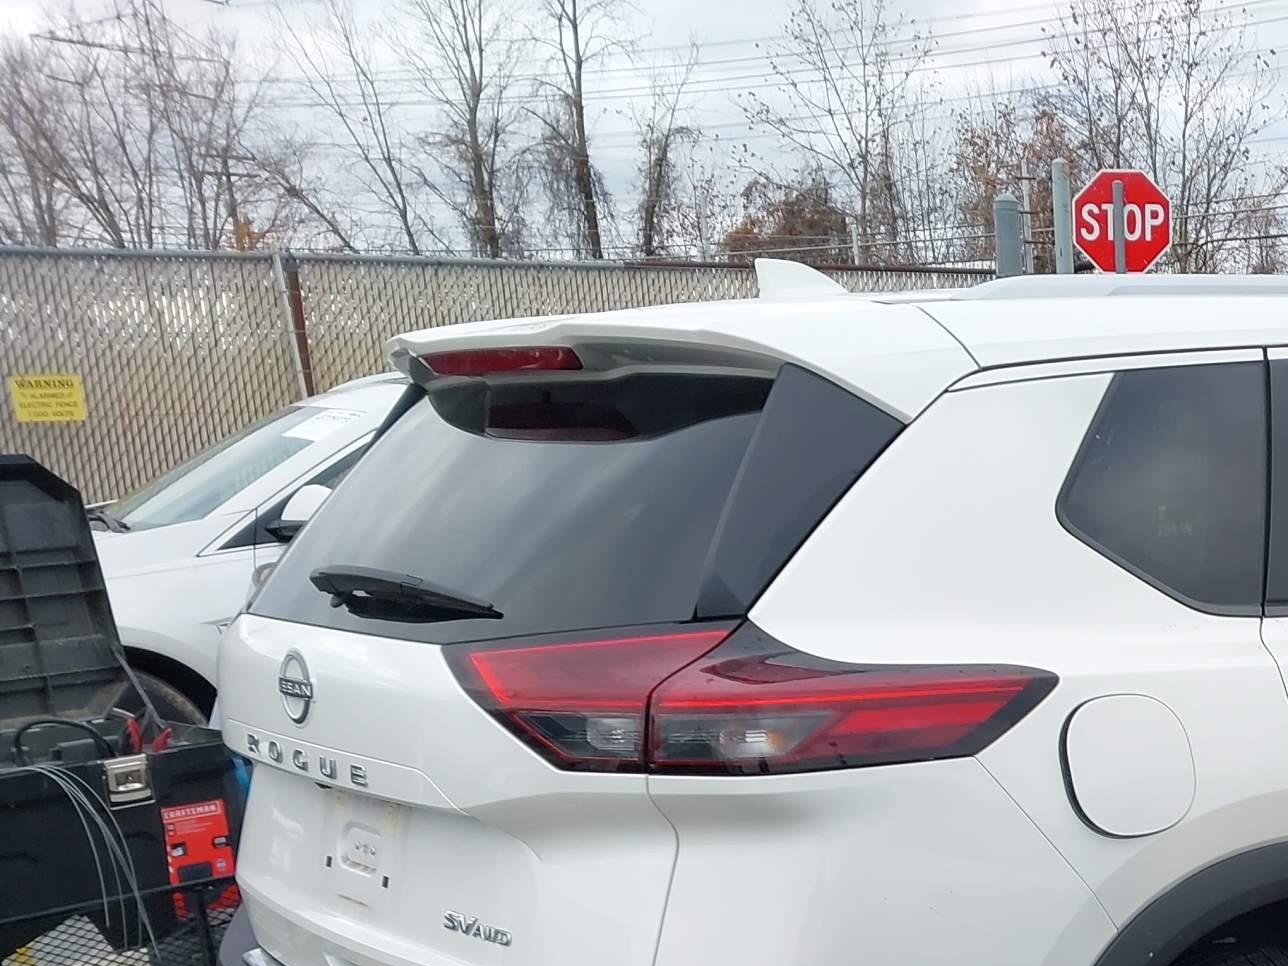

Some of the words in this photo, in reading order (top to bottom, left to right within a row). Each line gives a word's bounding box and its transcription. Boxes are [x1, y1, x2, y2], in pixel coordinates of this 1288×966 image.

[1080, 203, 1165, 242] STOP
[15, 379, 74, 389] WARNING
[280, 680, 312, 698] SSAN
[247, 732, 369, 788] ROGUE
